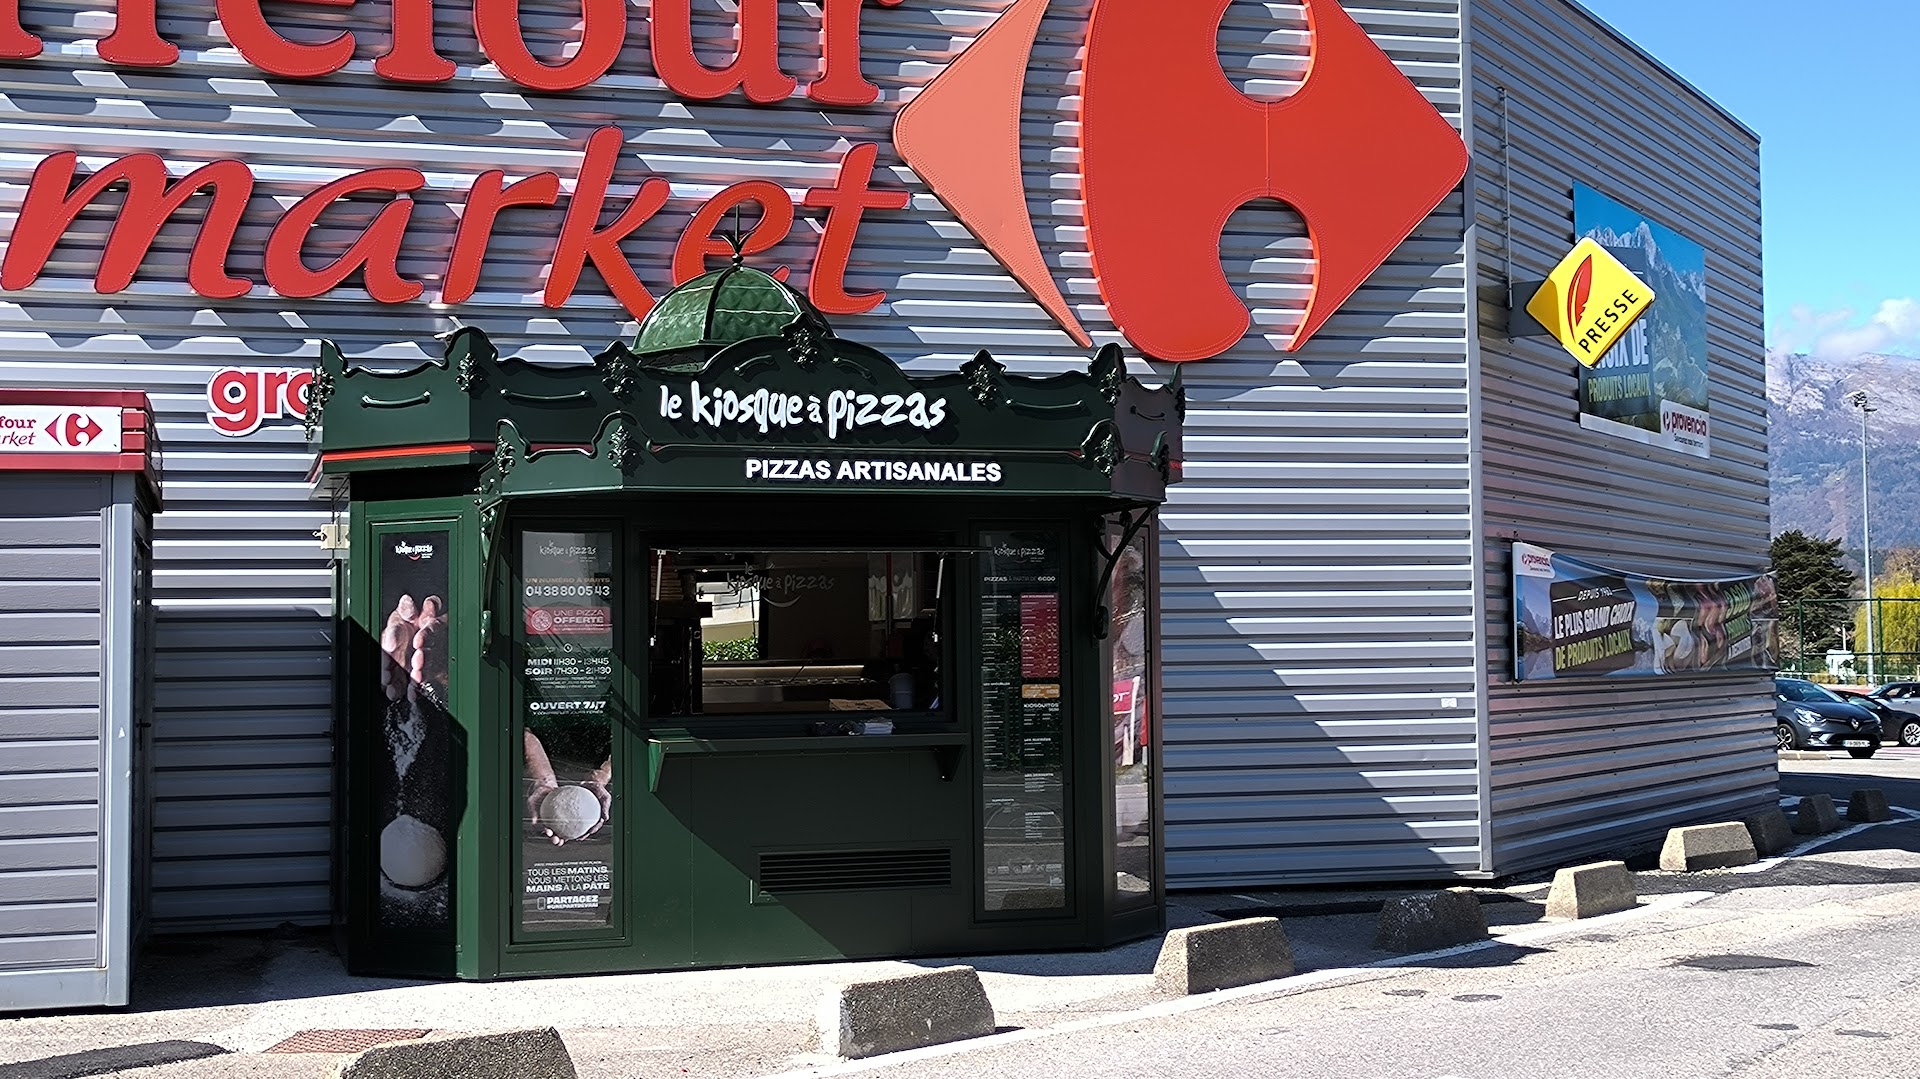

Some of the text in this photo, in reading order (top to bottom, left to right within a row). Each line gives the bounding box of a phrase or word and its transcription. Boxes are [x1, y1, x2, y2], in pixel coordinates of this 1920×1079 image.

[0, 126, 910, 323] market
[1578, 288, 1640, 354] PRESSE
[1631, 318, 1650, 366] DE
[1587, 372, 1651, 403] PRODUITS LOCAUX
[659, 380, 947, 440] le kiosque à pizzas
[1671, 411, 1707, 437] provencia
[0, 431, 37, 447] rket
[745, 458, 1003, 483] PIZZAS ARTISANALES
[553, 616, 604, 624] OFFERTE
[1554, 601, 1635, 640] LE PLUS GRAND CHOIX
[1555, 628, 1633, 671] DE PRODUITS LOCAUX
[525, 667, 553, 675] SOIR
[527, 658, 552, 666] MIDI
[529, 701, 581, 710] OUVERT
[527, 866, 608, 877] TOUS LES MATINS
[527, 874, 609, 885] NOUS METTONS LES
[525, 884, 563, 893] MAINS
[571, 883, 581, 891] LA
[582, 880, 610, 890] PÂTE
[546, 895, 599, 905] PARTAGEZ
